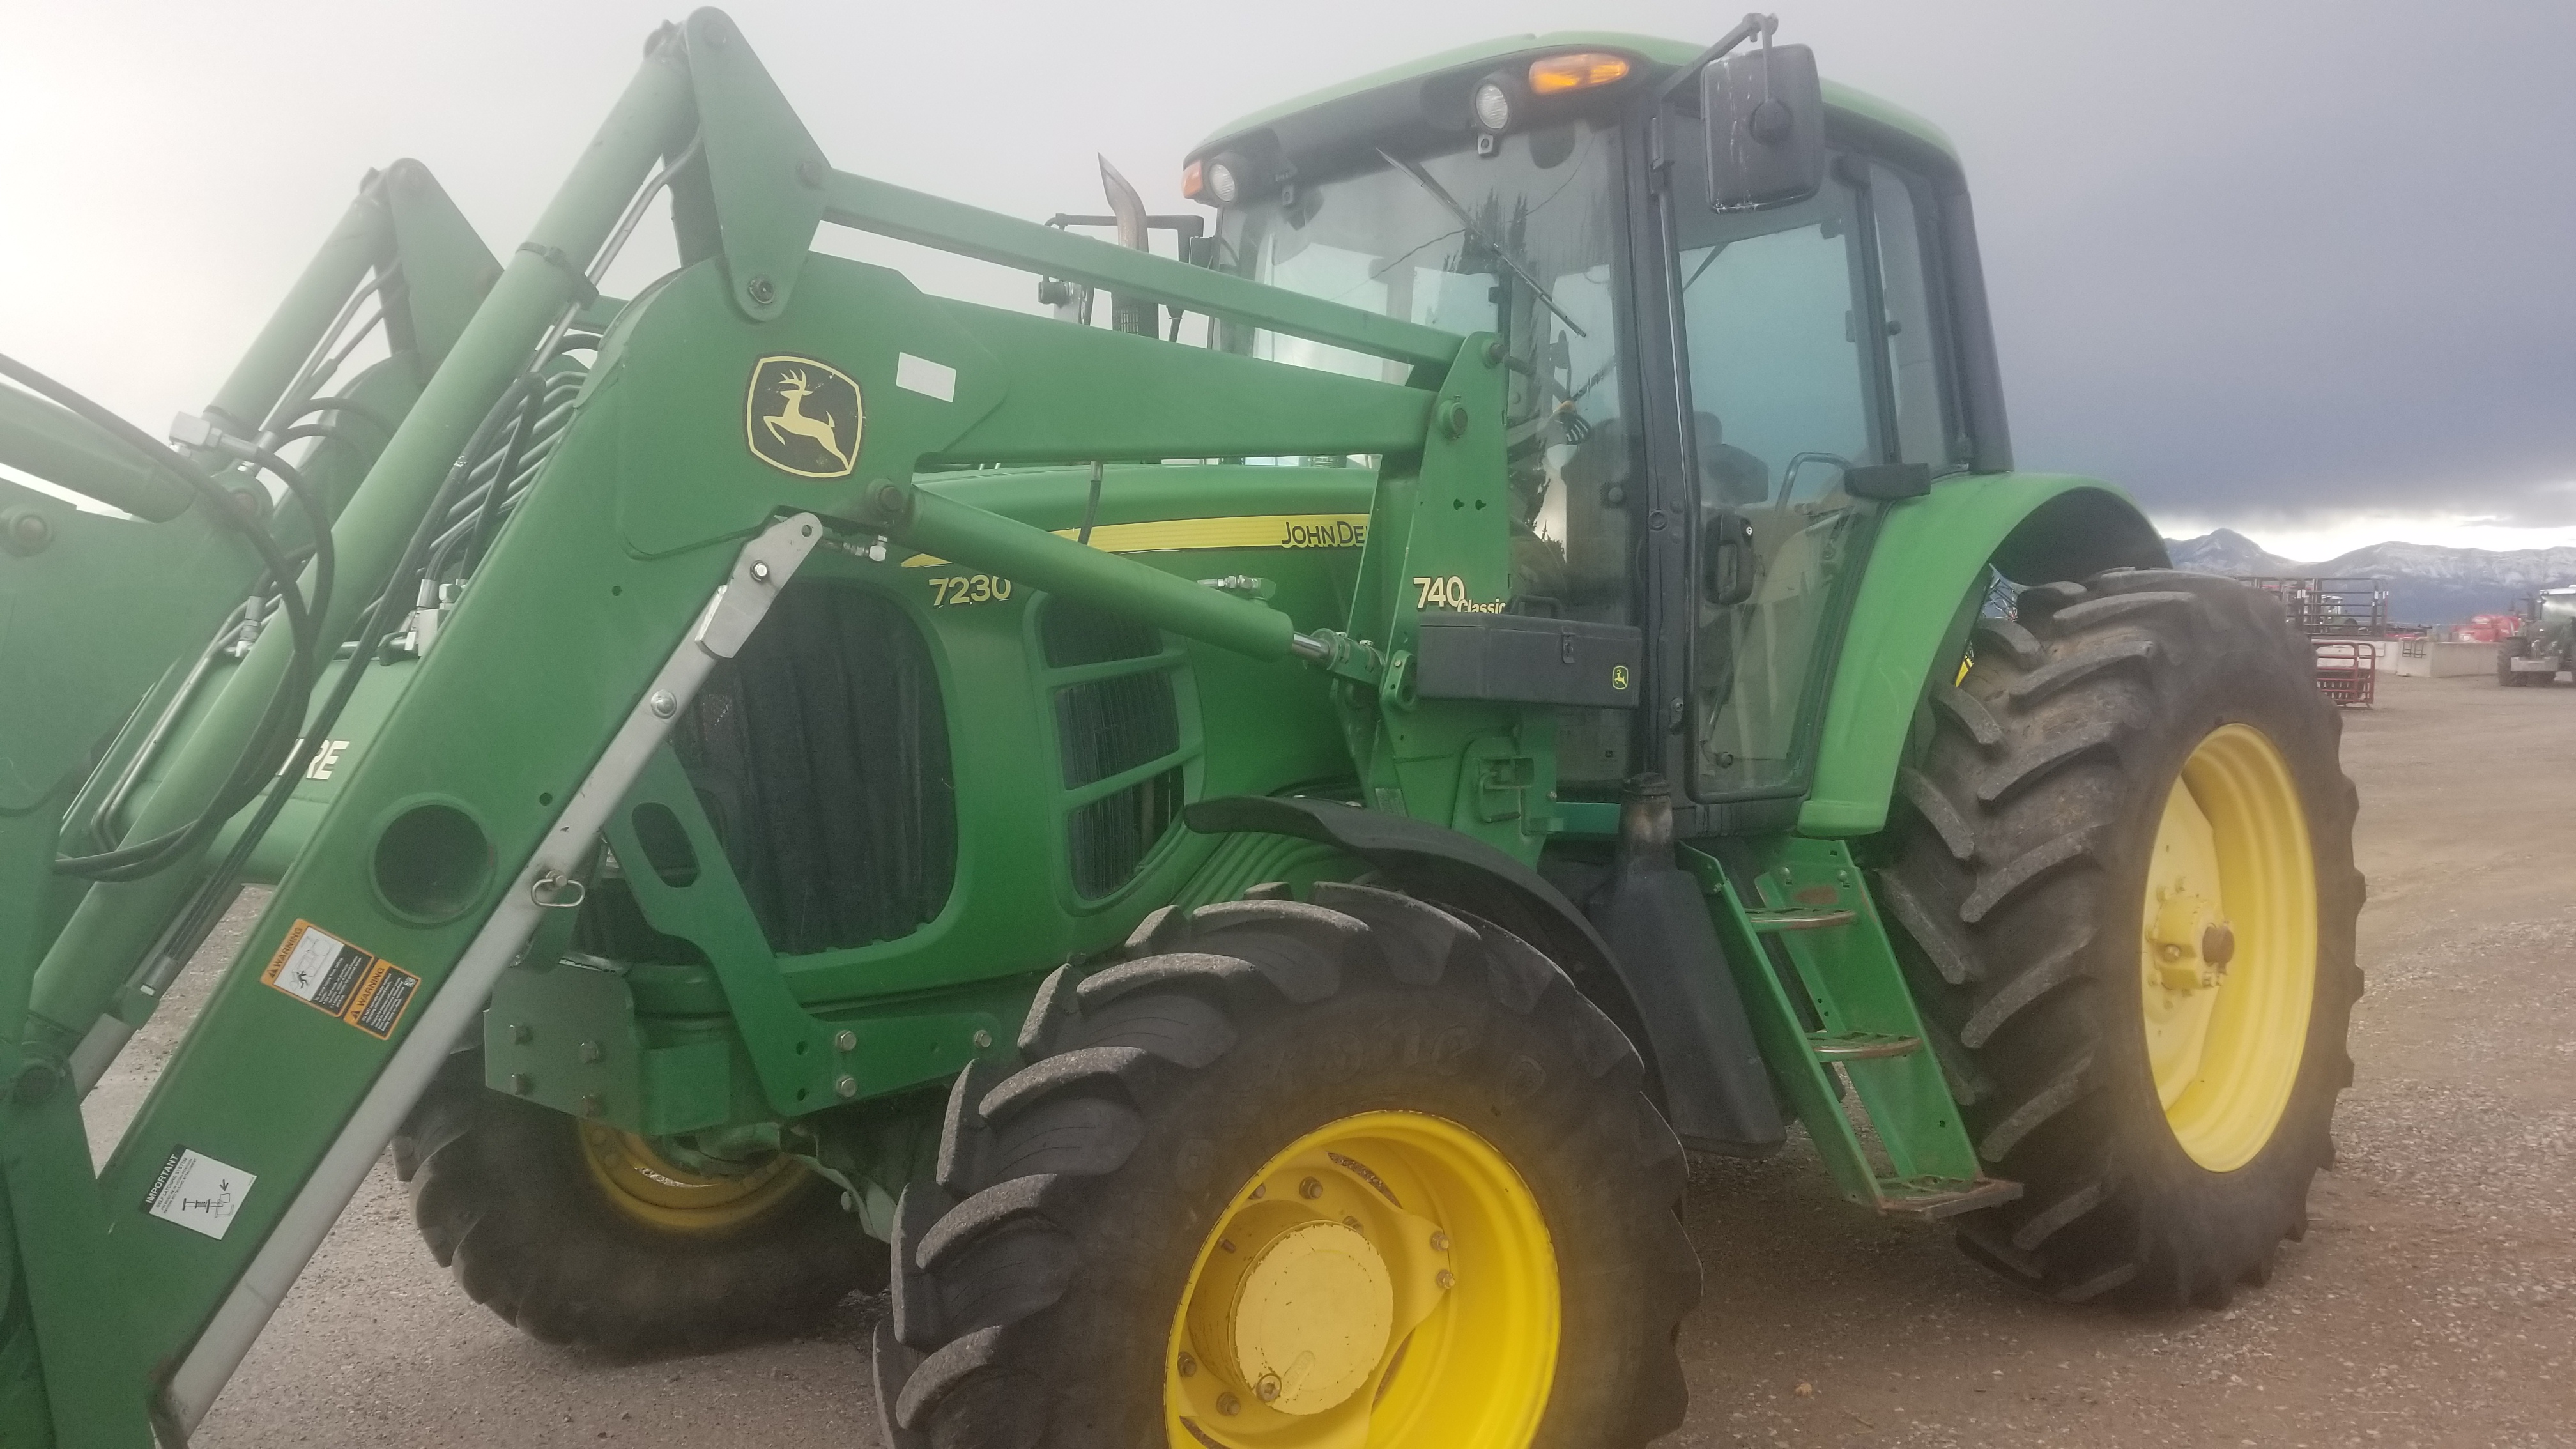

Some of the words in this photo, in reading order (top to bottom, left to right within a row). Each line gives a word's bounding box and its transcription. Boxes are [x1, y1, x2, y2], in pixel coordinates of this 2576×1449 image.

[1282, 521, 1336, 544] JOHN
[1337, 521, 1368, 544] DE
[929, 574, 1011, 606] 7230
[1413, 576, 1464, 608] 740
[273, 927, 302, 967] WARNING
[358, 967, 385, 1006] WARNING
[145, 1153, 178, 1203] IMPORTANT
